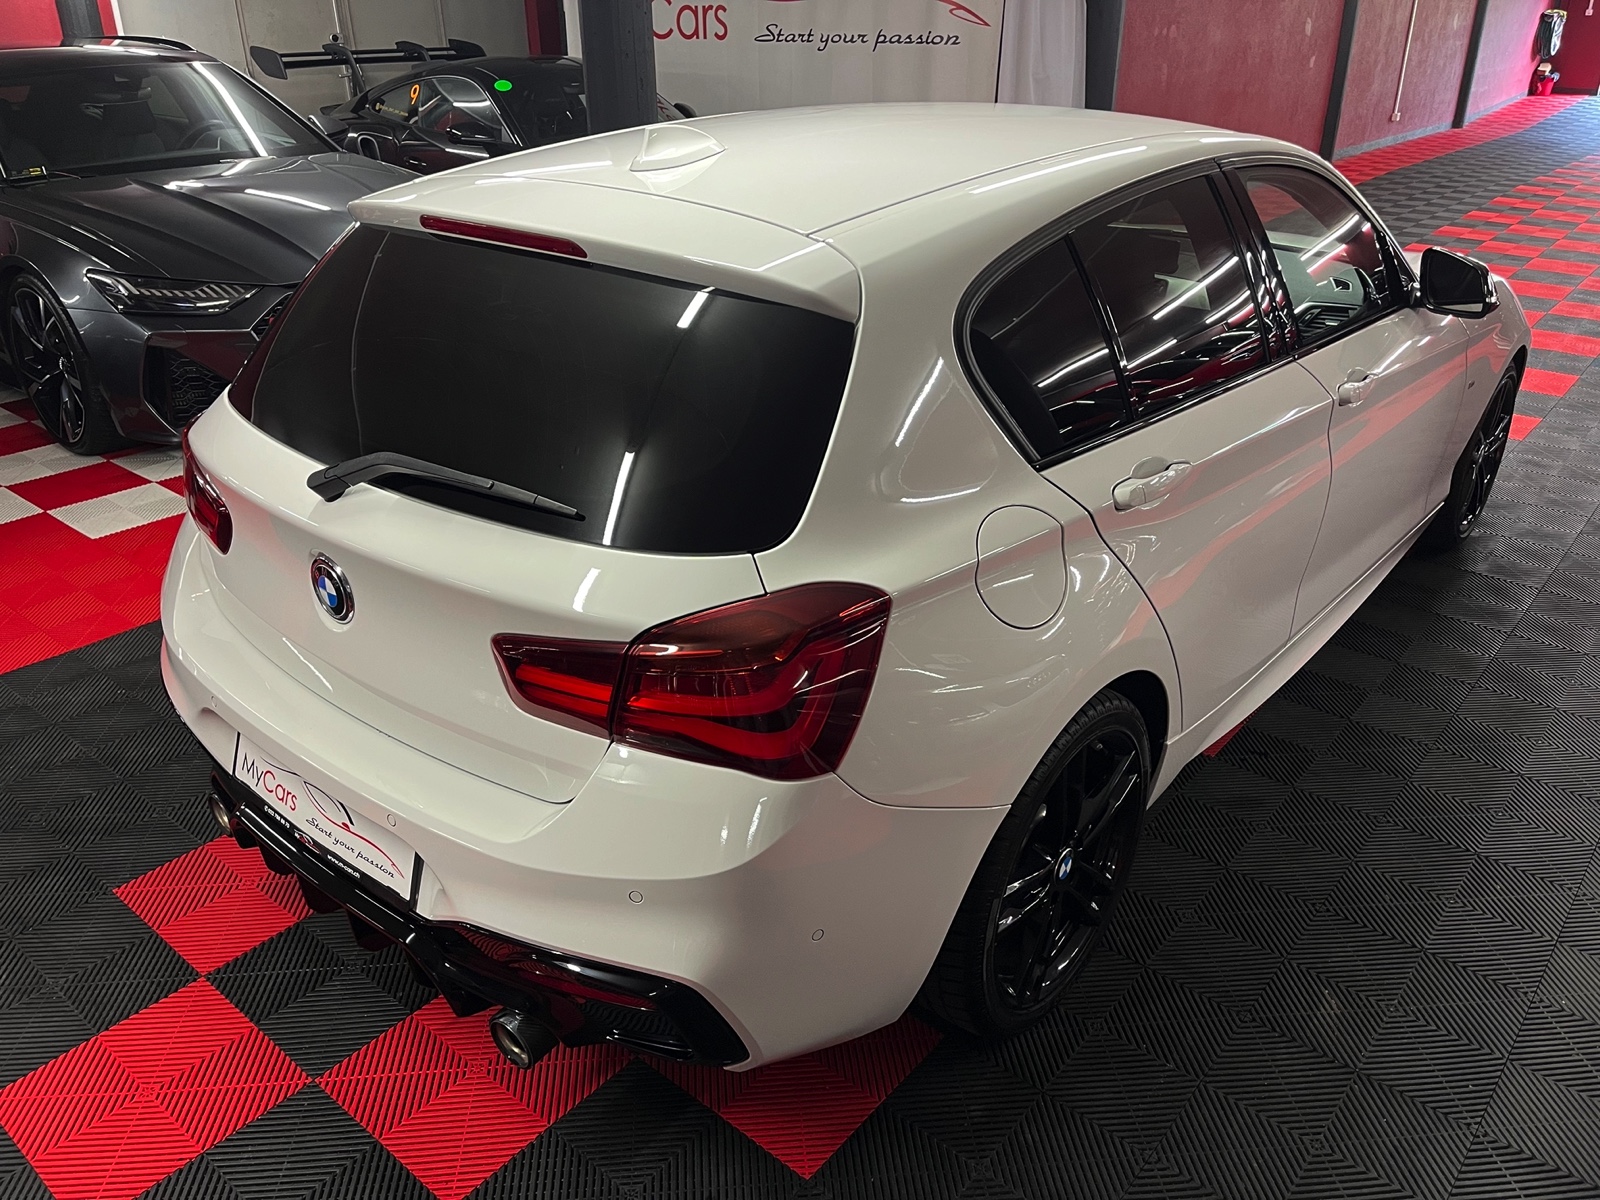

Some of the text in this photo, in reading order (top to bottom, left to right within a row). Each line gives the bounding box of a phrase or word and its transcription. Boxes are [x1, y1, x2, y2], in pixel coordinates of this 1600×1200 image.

[754, 23, 961, 52] Start your passion
[411, 84, 420, 105] 9
[241, 752, 298, 811] MyCars
[306, 817, 333, 839] Start
[332, 837, 355, 854] your
[355, 850, 395, 879] passion
